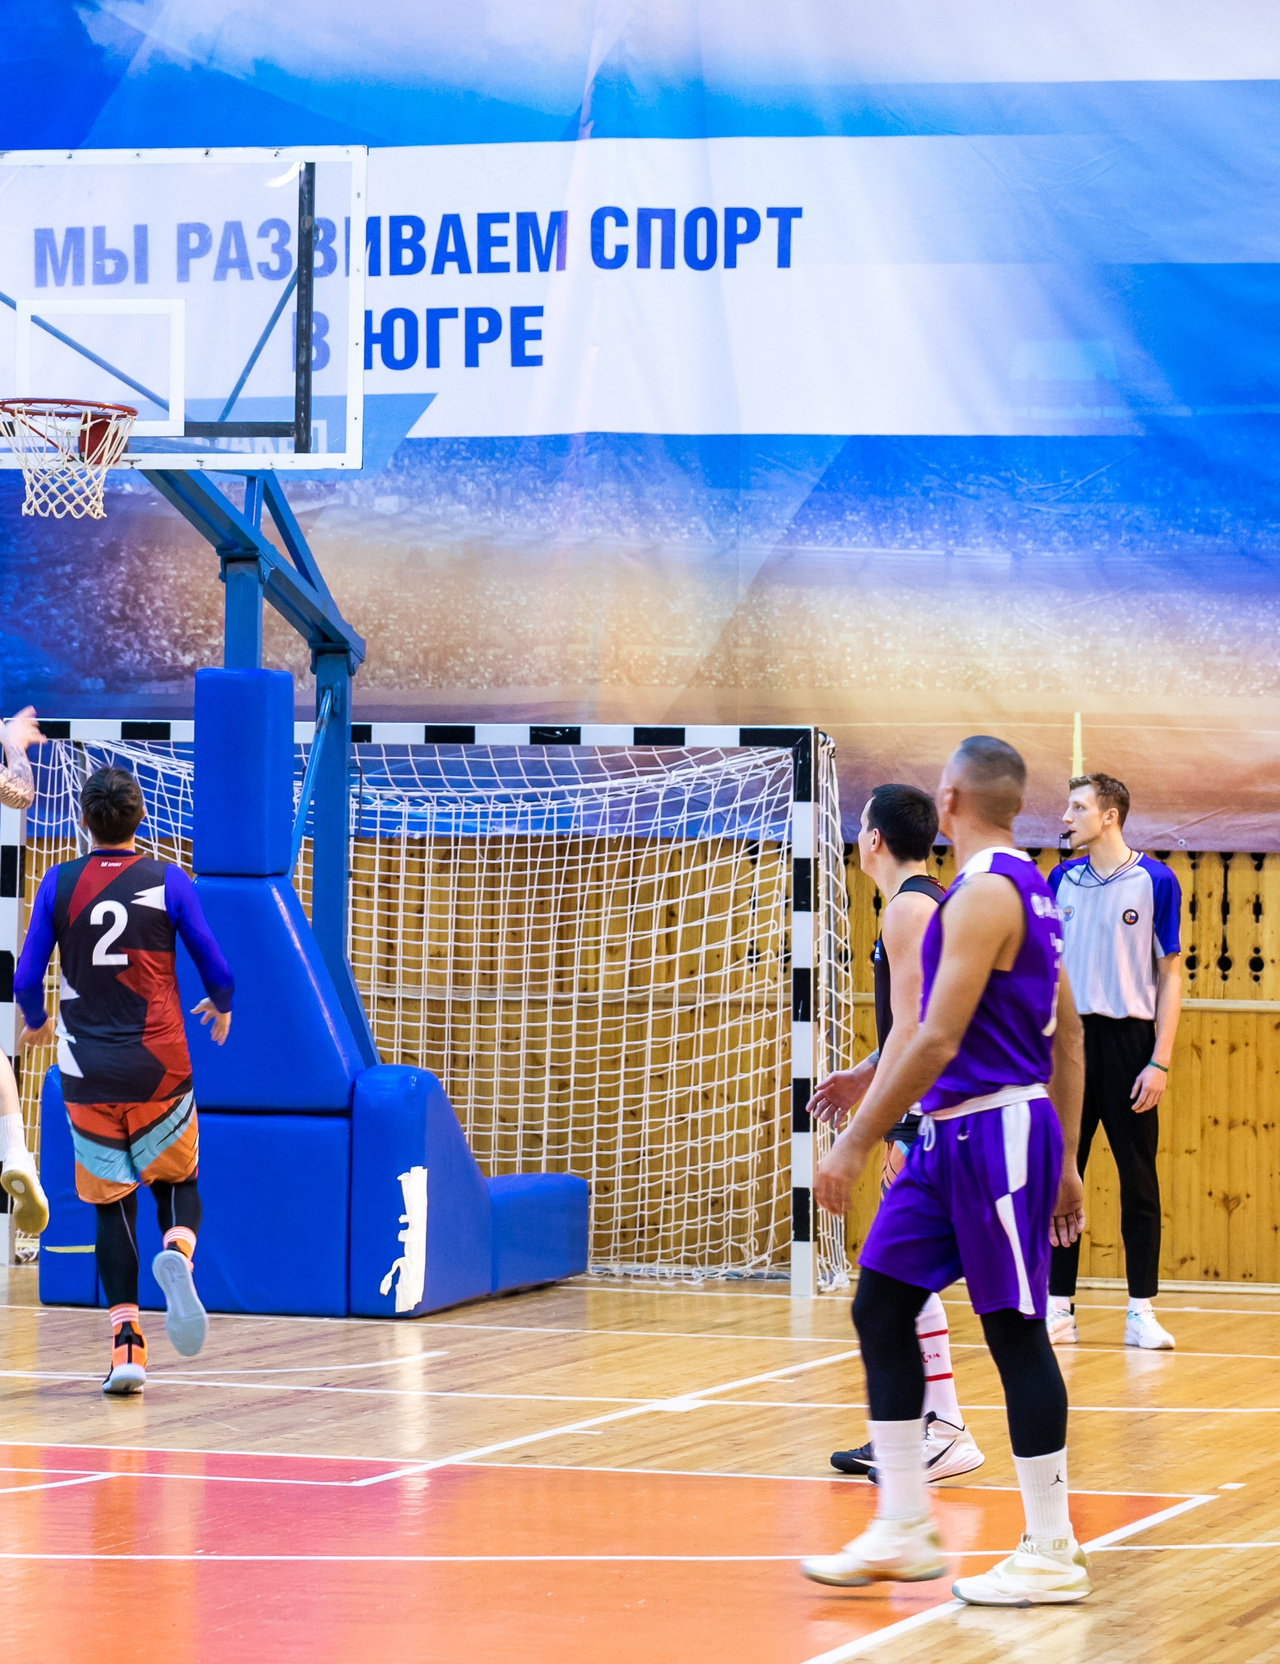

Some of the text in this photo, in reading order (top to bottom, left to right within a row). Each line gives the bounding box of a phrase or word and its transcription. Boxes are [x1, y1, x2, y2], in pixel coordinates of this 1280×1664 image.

[34, 206, 804, 287] МЫ РАЗВИВАЕМ СПОРТ
[364, 306, 544, 370] ЮГРЕ
[90, 900, 128, 965] 2
